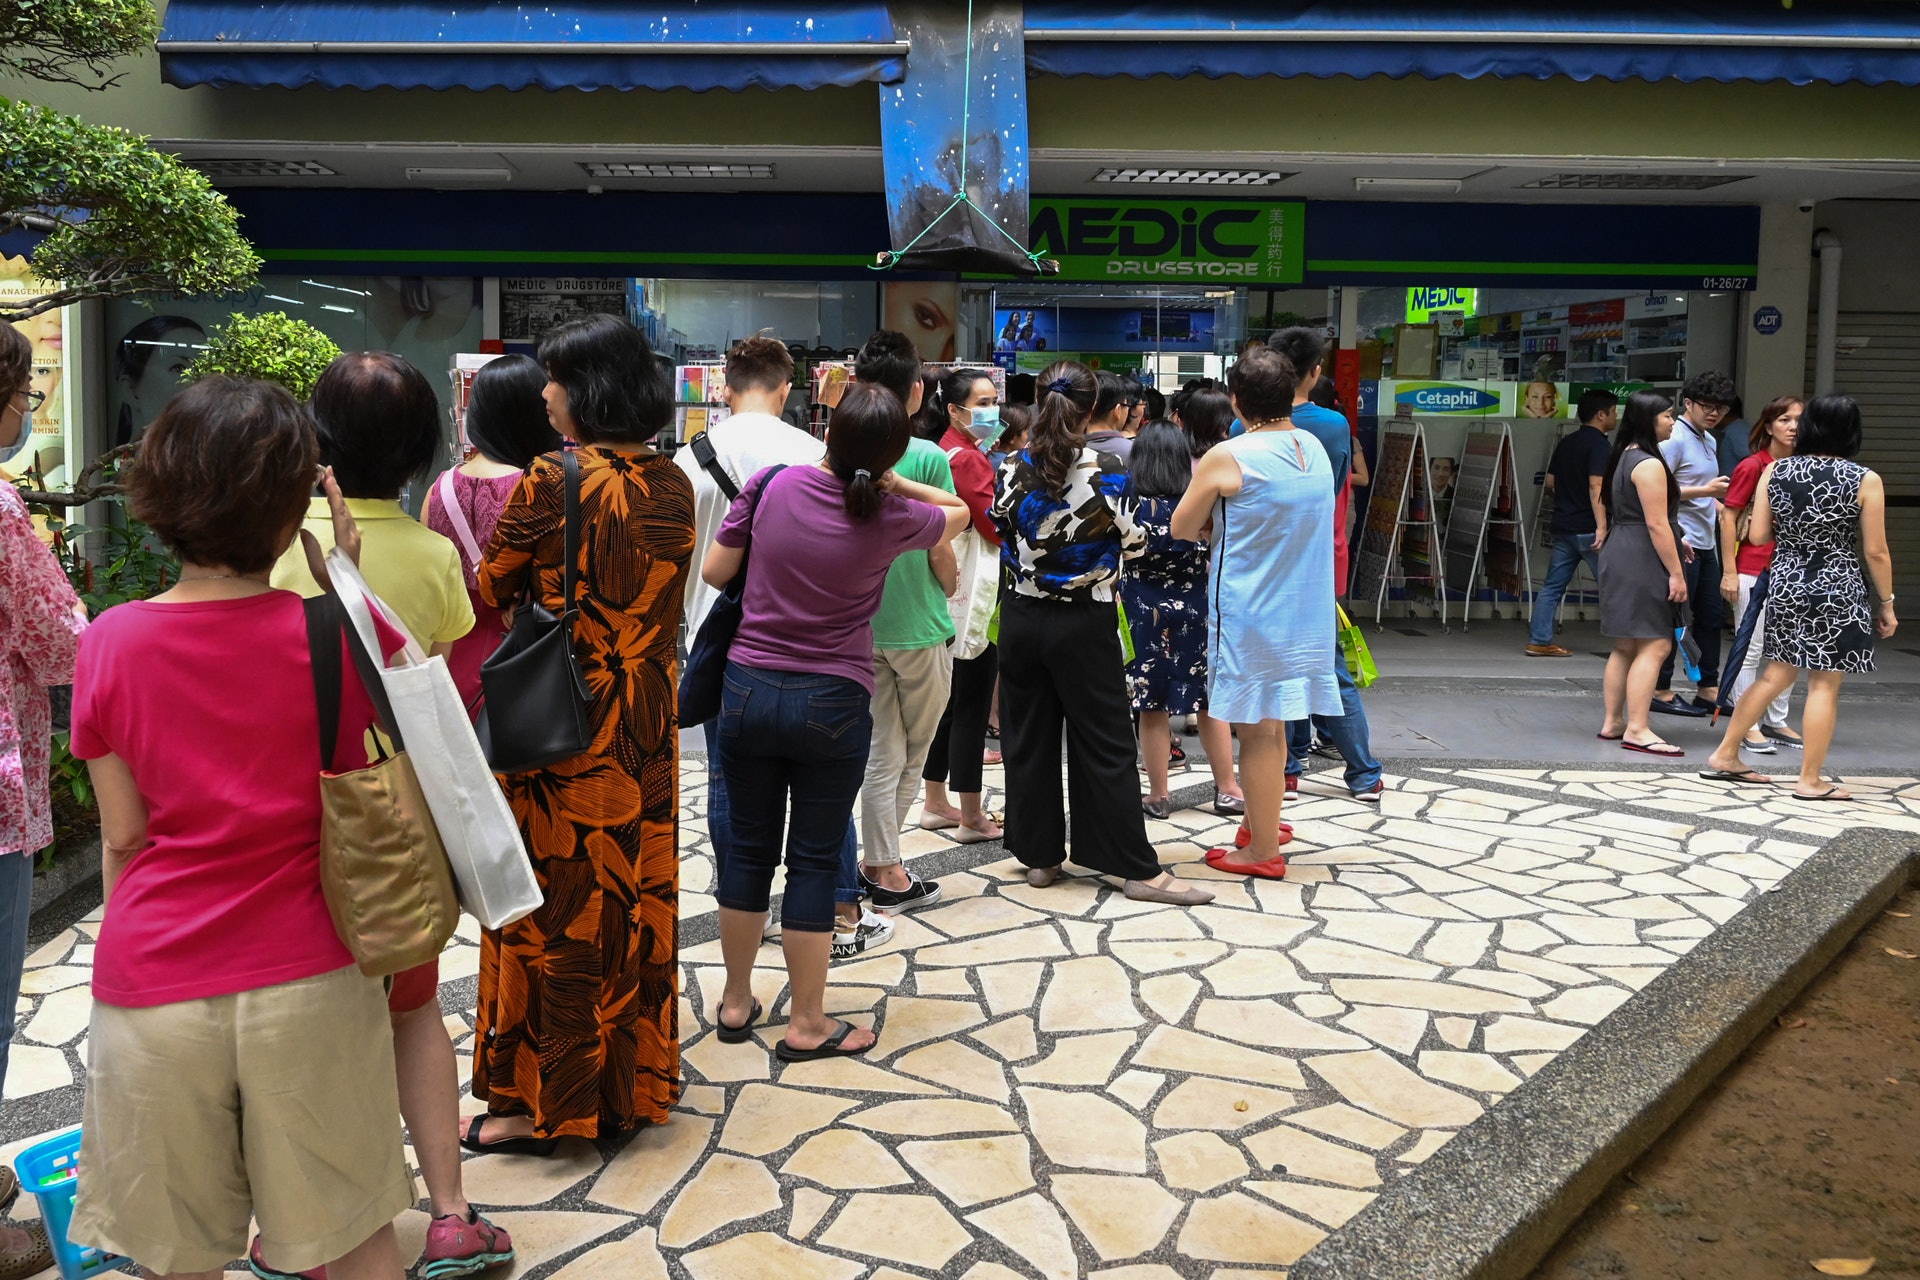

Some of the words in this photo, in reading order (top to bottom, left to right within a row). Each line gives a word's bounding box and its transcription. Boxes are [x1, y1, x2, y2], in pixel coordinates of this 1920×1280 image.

[1267, 208, 1283, 277] 美得药行
[1106, 260, 1259, 276] DRUGSTORE
[507, 280, 546, 290] MEDIC
[556, 280, 623, 290] DRUGSTORE
[1703, 277, 1748, 289] 01-26/27
[1758, 315, 1778, 326] ADT
[1365, 385, 1376, 393] QV
[1416, 391, 1478, 409] Cetaphil
